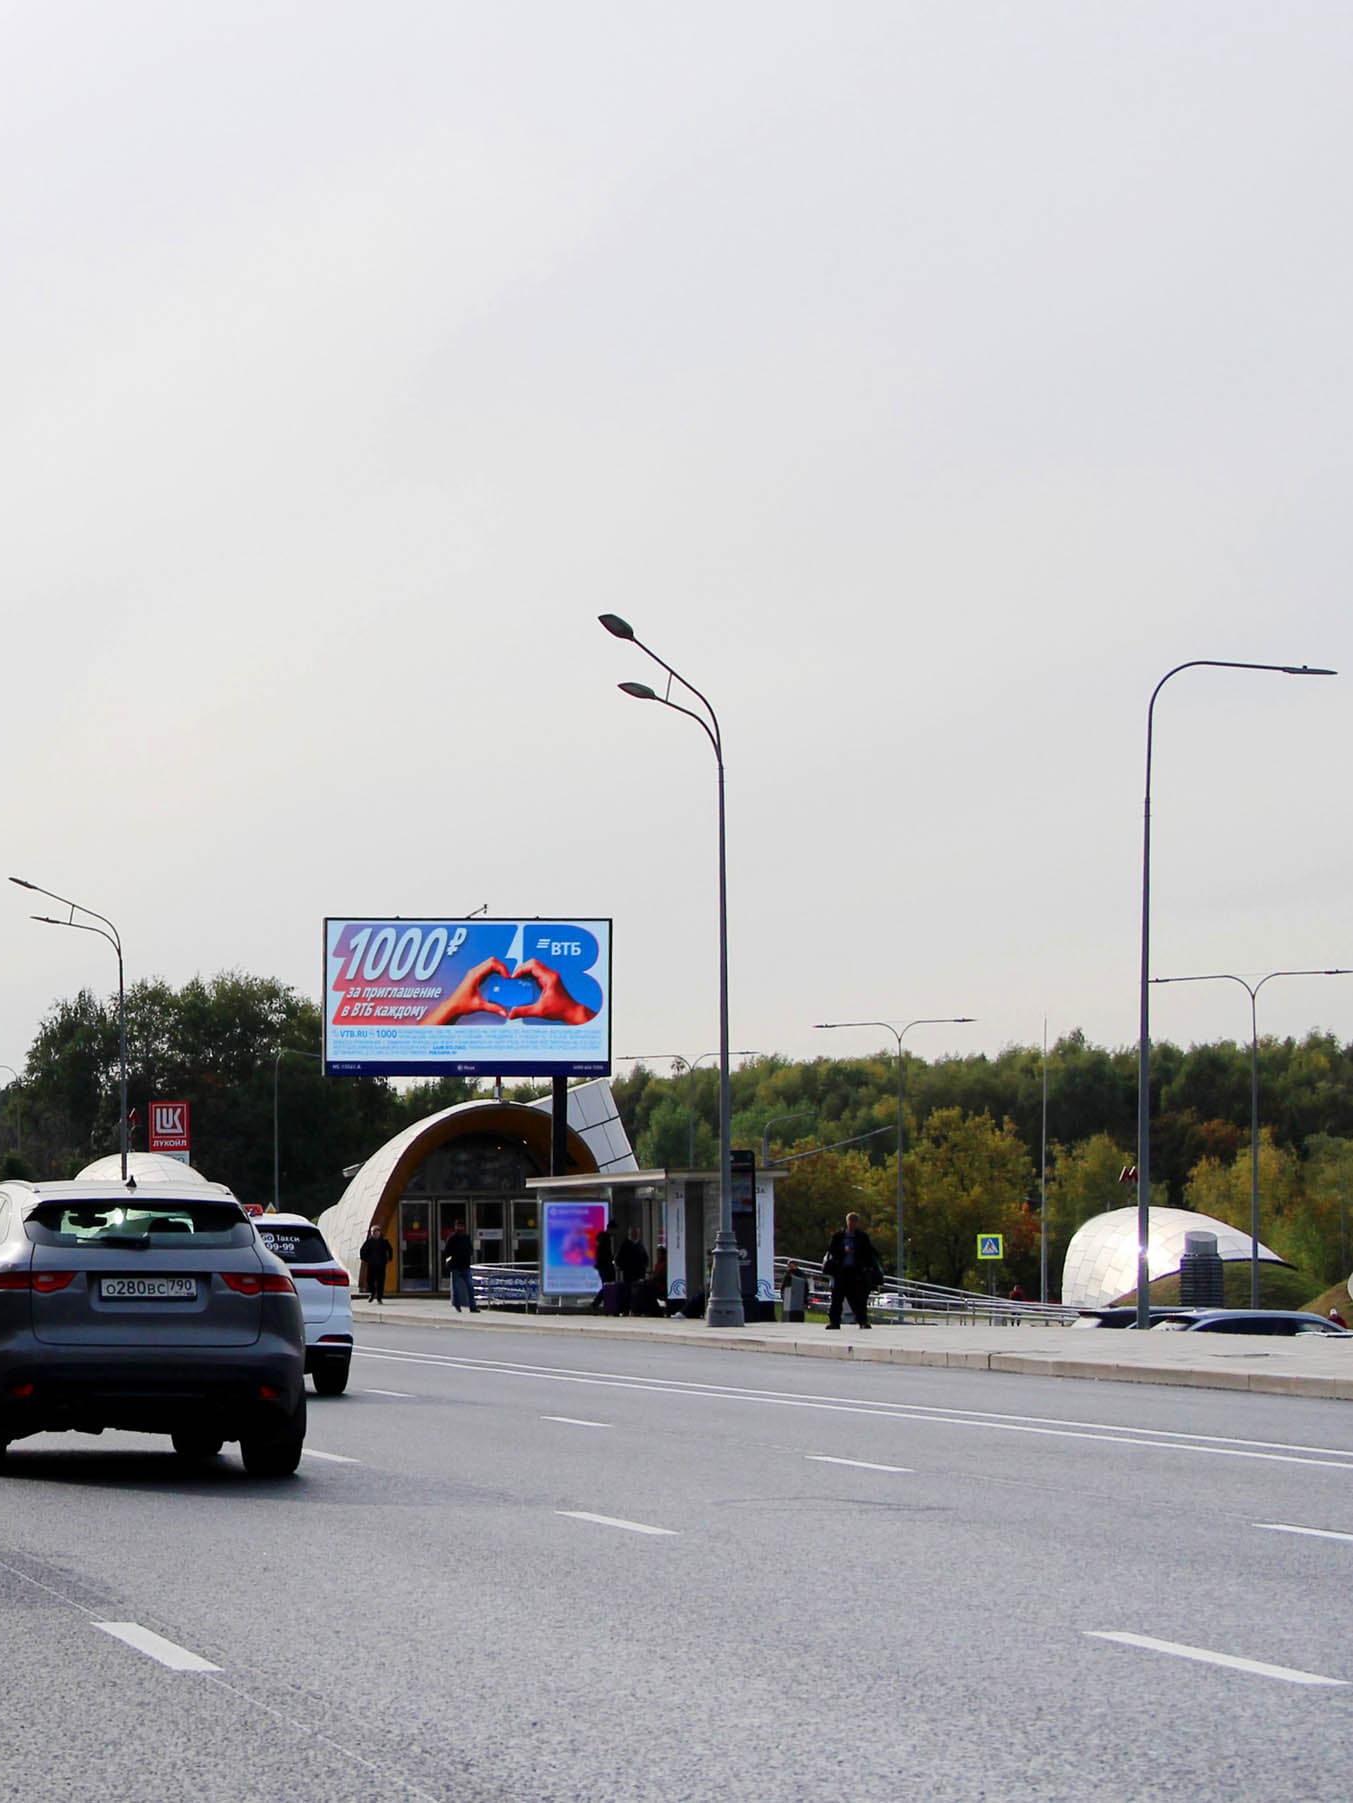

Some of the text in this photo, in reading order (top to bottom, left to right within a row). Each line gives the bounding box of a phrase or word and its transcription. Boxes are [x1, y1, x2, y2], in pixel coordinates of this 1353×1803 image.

[551, 941, 582, 956] ВТБ
[347, 987, 442, 1001] за приглашение
[341, 1003, 427, 1020] в ВТБ каждому
[339, 1030, 368, 1038] VTB.RU
[376, 1030, 398, 1038] 1000
[153, 1139, 187, 1147] ЛУКОЙЛ
